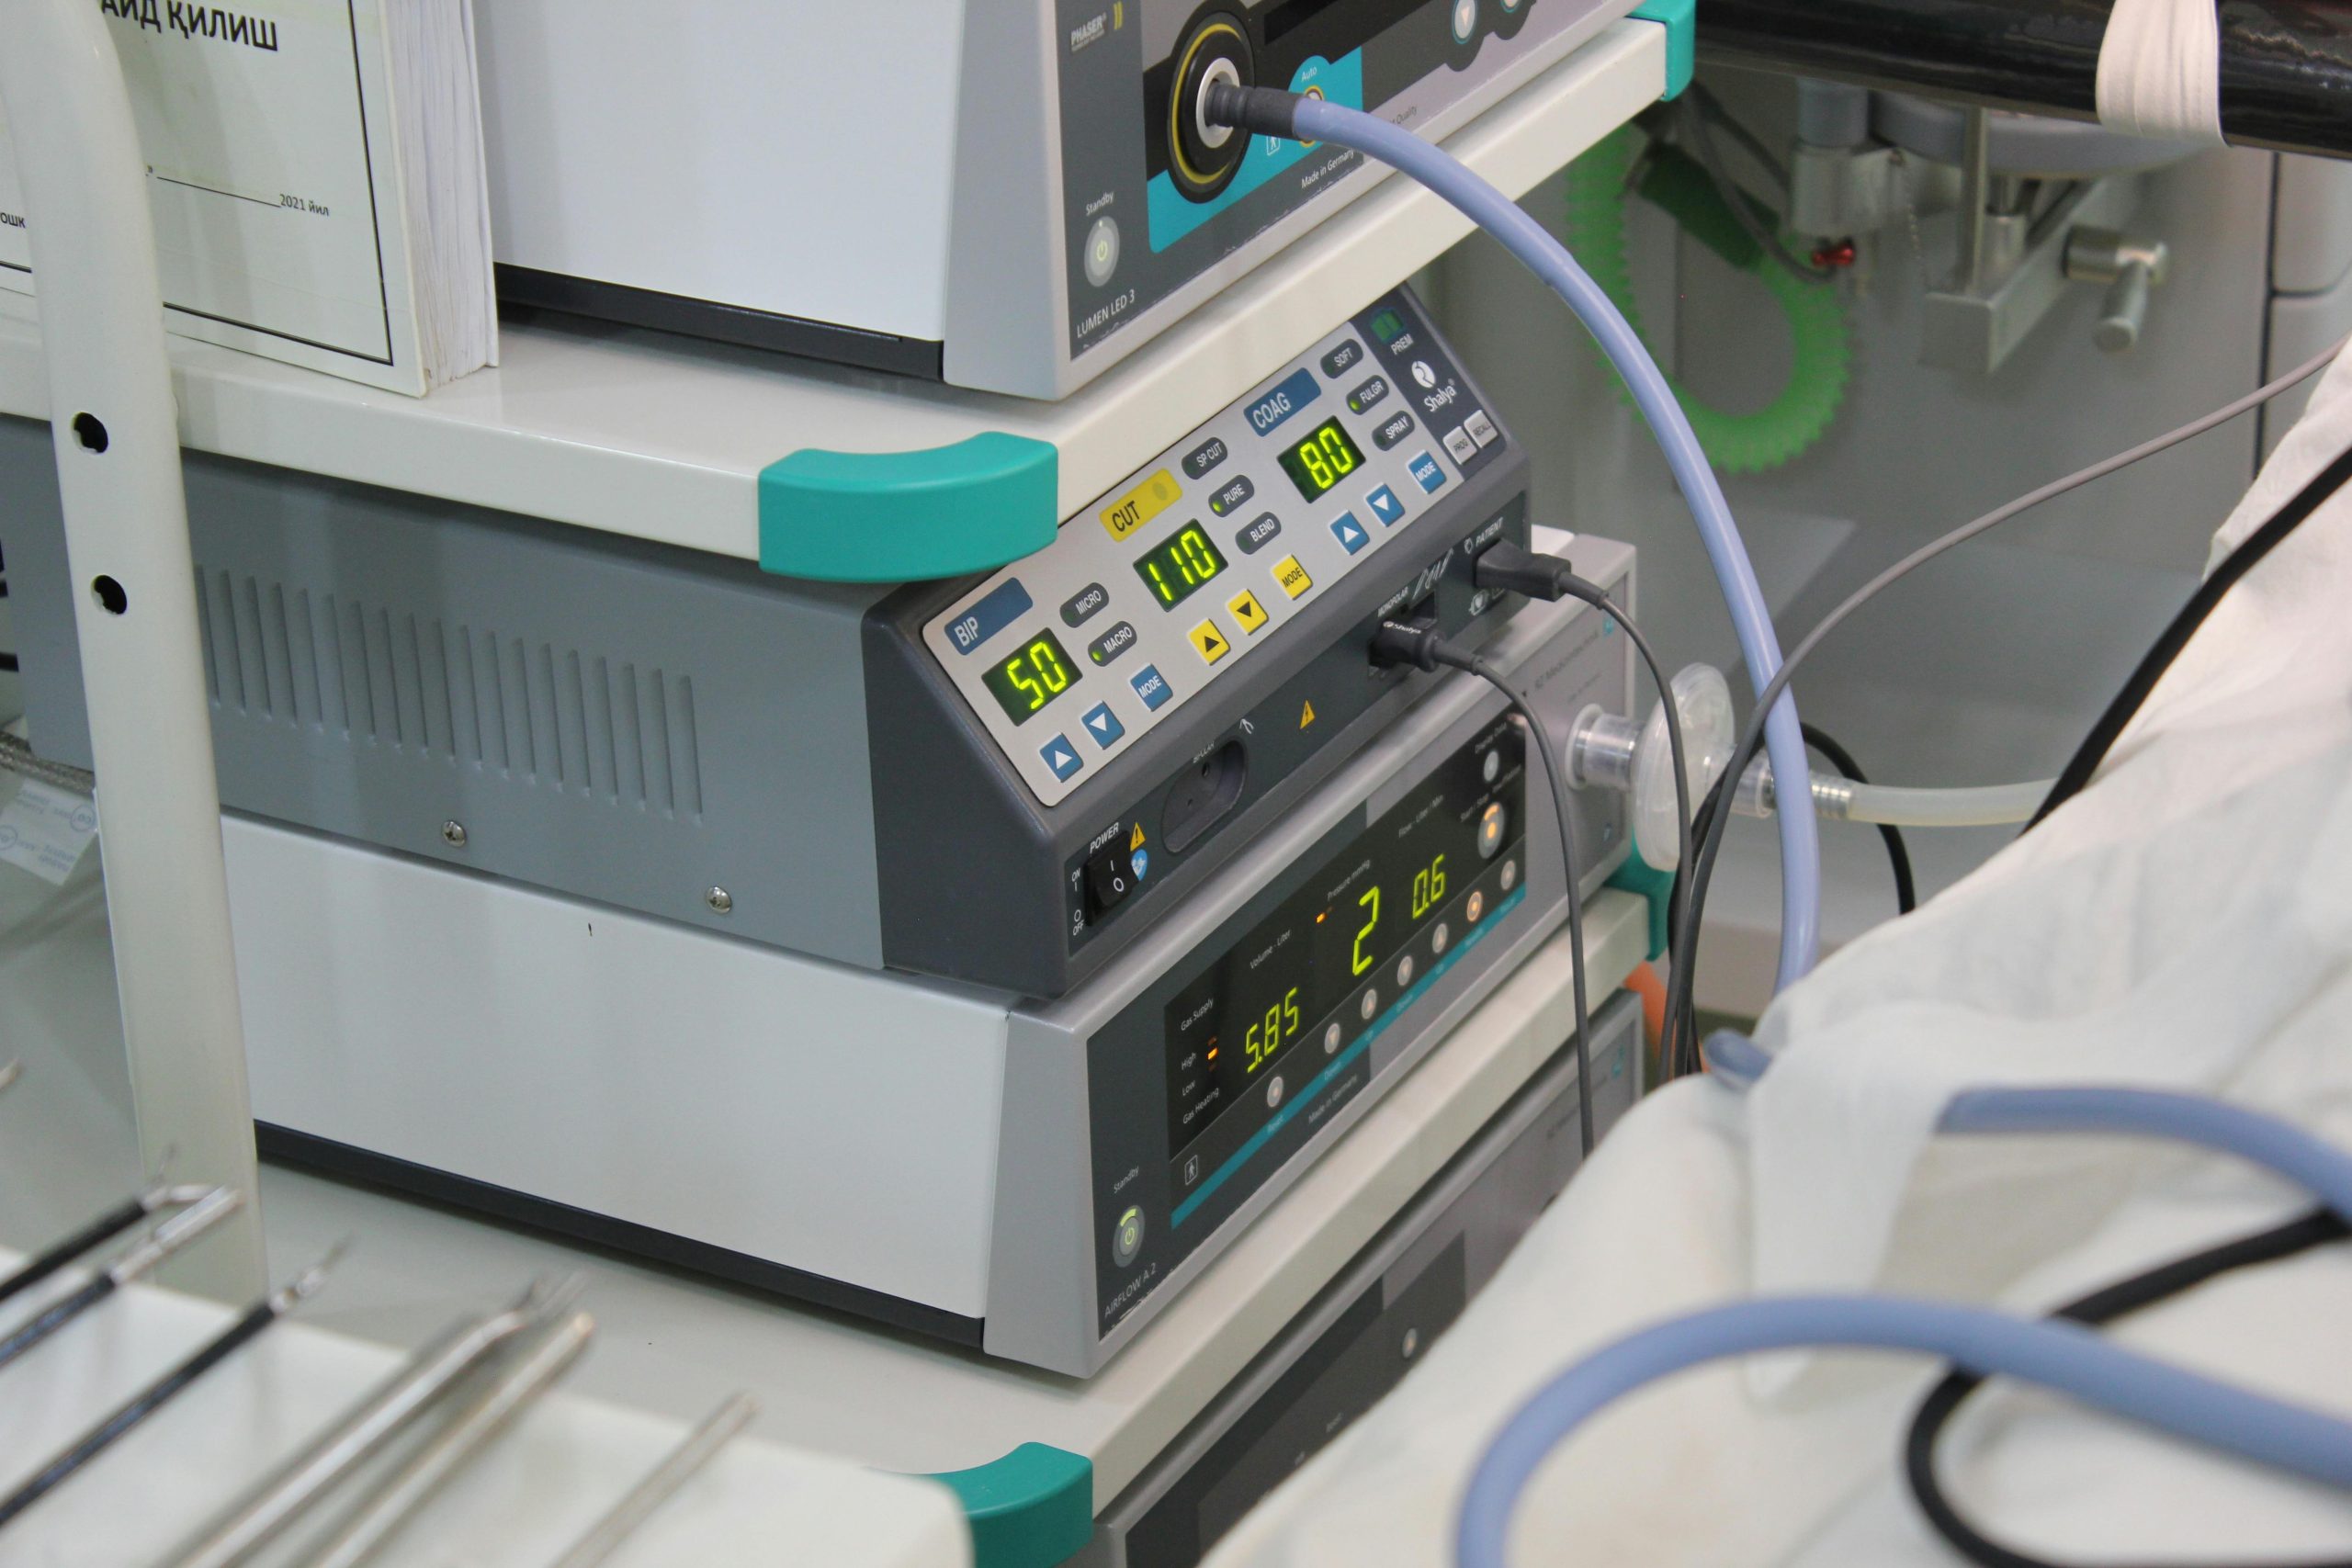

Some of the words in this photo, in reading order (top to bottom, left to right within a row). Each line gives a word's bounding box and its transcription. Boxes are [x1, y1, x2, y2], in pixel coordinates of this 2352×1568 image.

[167, 0, 277, 51] ҚИЛИШ
[1301, 66, 1317, 82] Auto
[1396, 105, 1418, 125] Quality
[1301, 171, 1319, 189] Made
[1320, 166, 1327, 176] in
[1327, 148, 1354, 171] Germany
[279, 194, 306, 211] 2021
[308, 200, 329, 217] йил
[1086, 191, 1114, 217] Standby
[1077, 308, 1109, 339] LUMEN
[1111, 294, 1127, 317] LED
[1129, 288, 1136, 304] 3
[1333, 346, 1353, 367] SOFT
[1390, 333, 1415, 355] PREM
[1359, 380, 1385, 404] FULGR
[1252, 391, 1292, 429] COAG
[1385, 415, 1410, 439] SPRAY
[1472, 422, 1492, 436] RECALL
[1196, 453, 1207, 468] SP
[1206, 443, 1223, 460] CUT
[1299, 426, 1353, 490] 80
[1453, 438, 1468, 454] PROG
[1415, 461, 1437, 482] MODE
[1223, 483, 1245, 505] PURE
[1111, 501, 1140, 533] CUT
[1250, 518, 1275, 542] BLEND
[1476, 516, 1504, 547] PATIENT
[1148, 529, 1216, 602] 110
[1281, 567, 1303, 588] MODE
[1075, 590, 1102, 615] MICRO
[1377, 586, 1409, 617] MONOPOLAR
[954, 616, 978, 647] BIP
[1102, 626, 1133, 654] MACRO
[1007, 641, 1067, 710] 50
[1137, 675, 1162, 698] MODE
[1090, 821, 1119, 854] POWER
[1071, 868, 1080, 883] ON
[1327, 875, 1351, 901] Pressure
[1351, 859, 1371, 881] mmHg
[1412, 852, 1446, 919] 0.6
[1072, 921, 1084, 936] OFF
[1352, 886, 1380, 976] 2
[1250, 945, 1273, 969] Volume
[1277, 930, 1292, 947] Liter
[1181, 1015, 1193, 1032] Gas
[1193, 998, 1214, 1021] Supply
[1245, 986, 1300, 1074] 5.85
[1181, 1052, 1196, 1070] High
[1182, 1080, 1195, 1097] Low
[1182, 1109, 1194, 1124] Gas
[1193, 1087, 1219, 1116] Heating
[1114, 1166, 1139, 1194] Standby
[1104, 1276, 1142, 1318] AIRFLOW
[1143, 1269, 1149, 1281] A
[1150, 1262, 1157, 1275] 2
